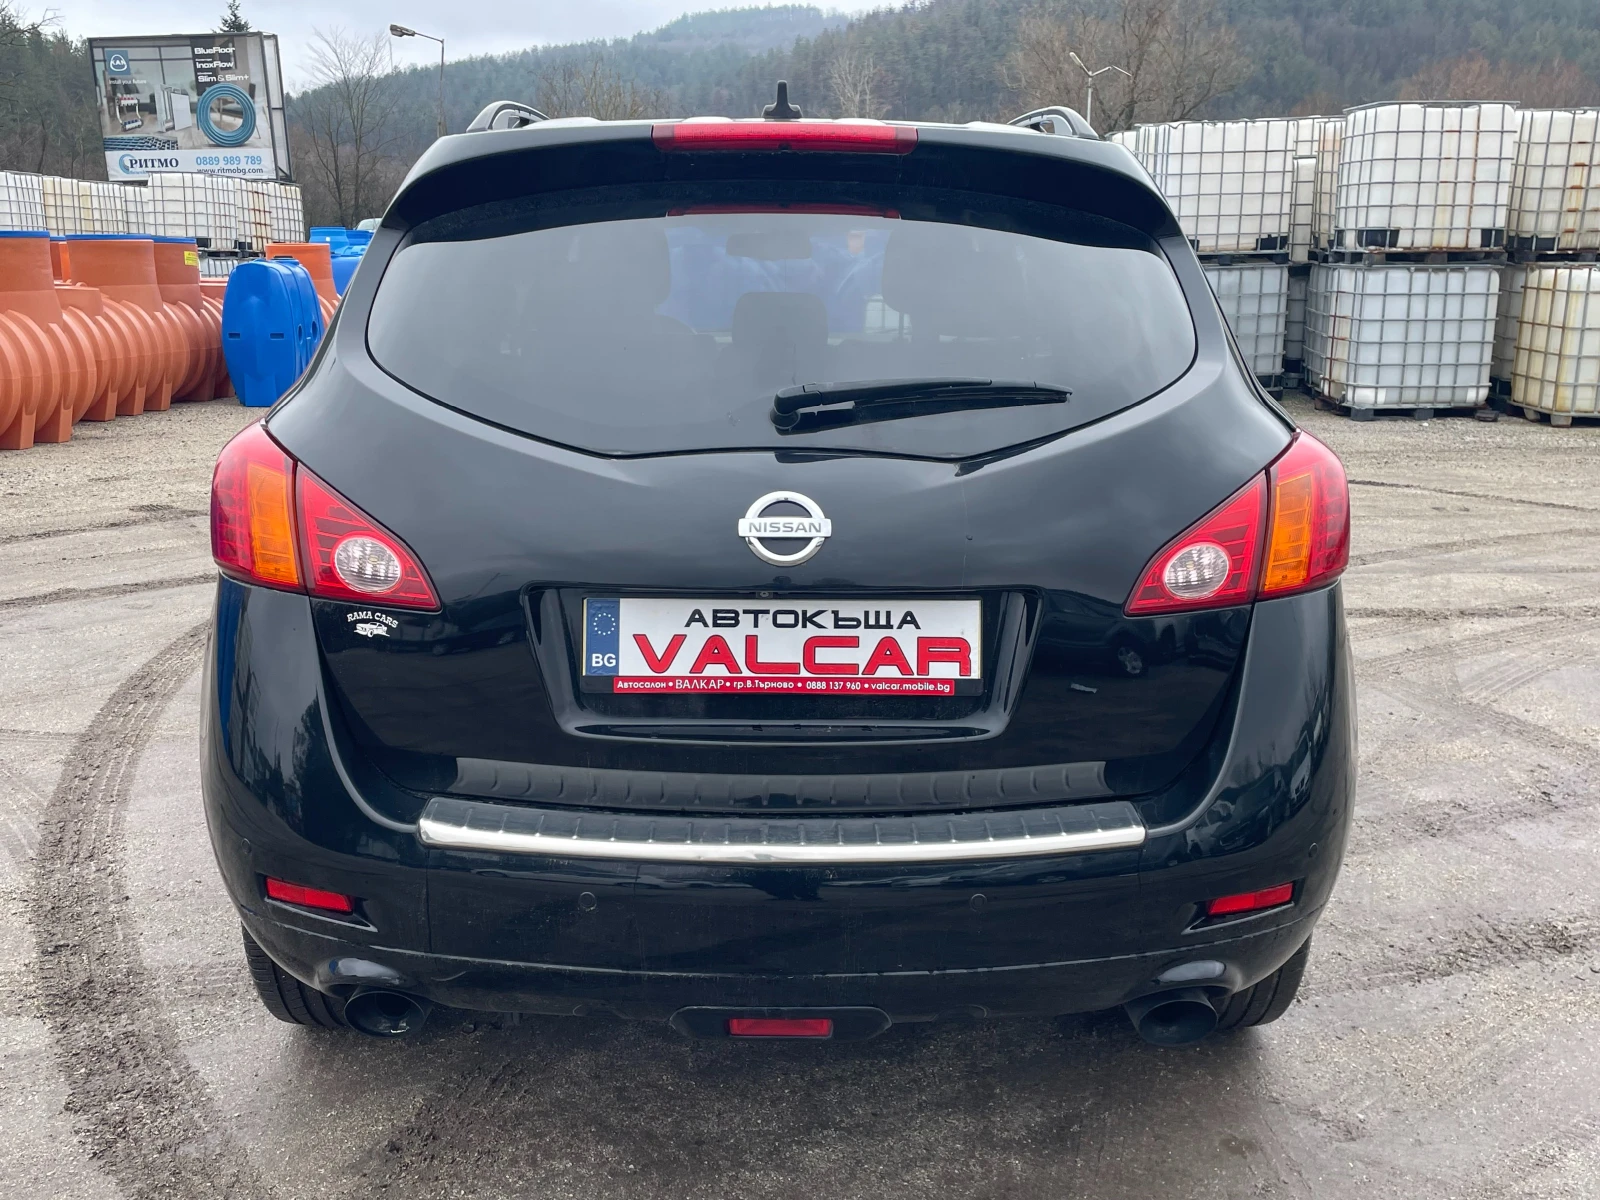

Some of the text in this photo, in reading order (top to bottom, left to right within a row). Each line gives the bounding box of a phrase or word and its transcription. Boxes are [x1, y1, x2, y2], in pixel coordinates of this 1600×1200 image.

[129, 158, 179, 168] РИТМО
[196, 155, 262, 165] 0889 989 789
[197, 167, 264, 175] www.ritmobg.com
[749, 522, 822, 533] NISSAN
[347, 611, 399, 628] RAMA CARS
[684, 608, 921, 630] АВТОКЪЩА
[592, 653, 616, 667] BG
[633, 634, 972, 676] VALCAR
[617, 681, 667, 689] Автосалон
[675, 679, 724, 689] ВАЛКАР
[806, 681, 827, 690] 0888
[829, 681, 843, 690] 137
[846, 681, 861, 690] 960
[871, 682, 950, 692] valcar.mobile.bg
